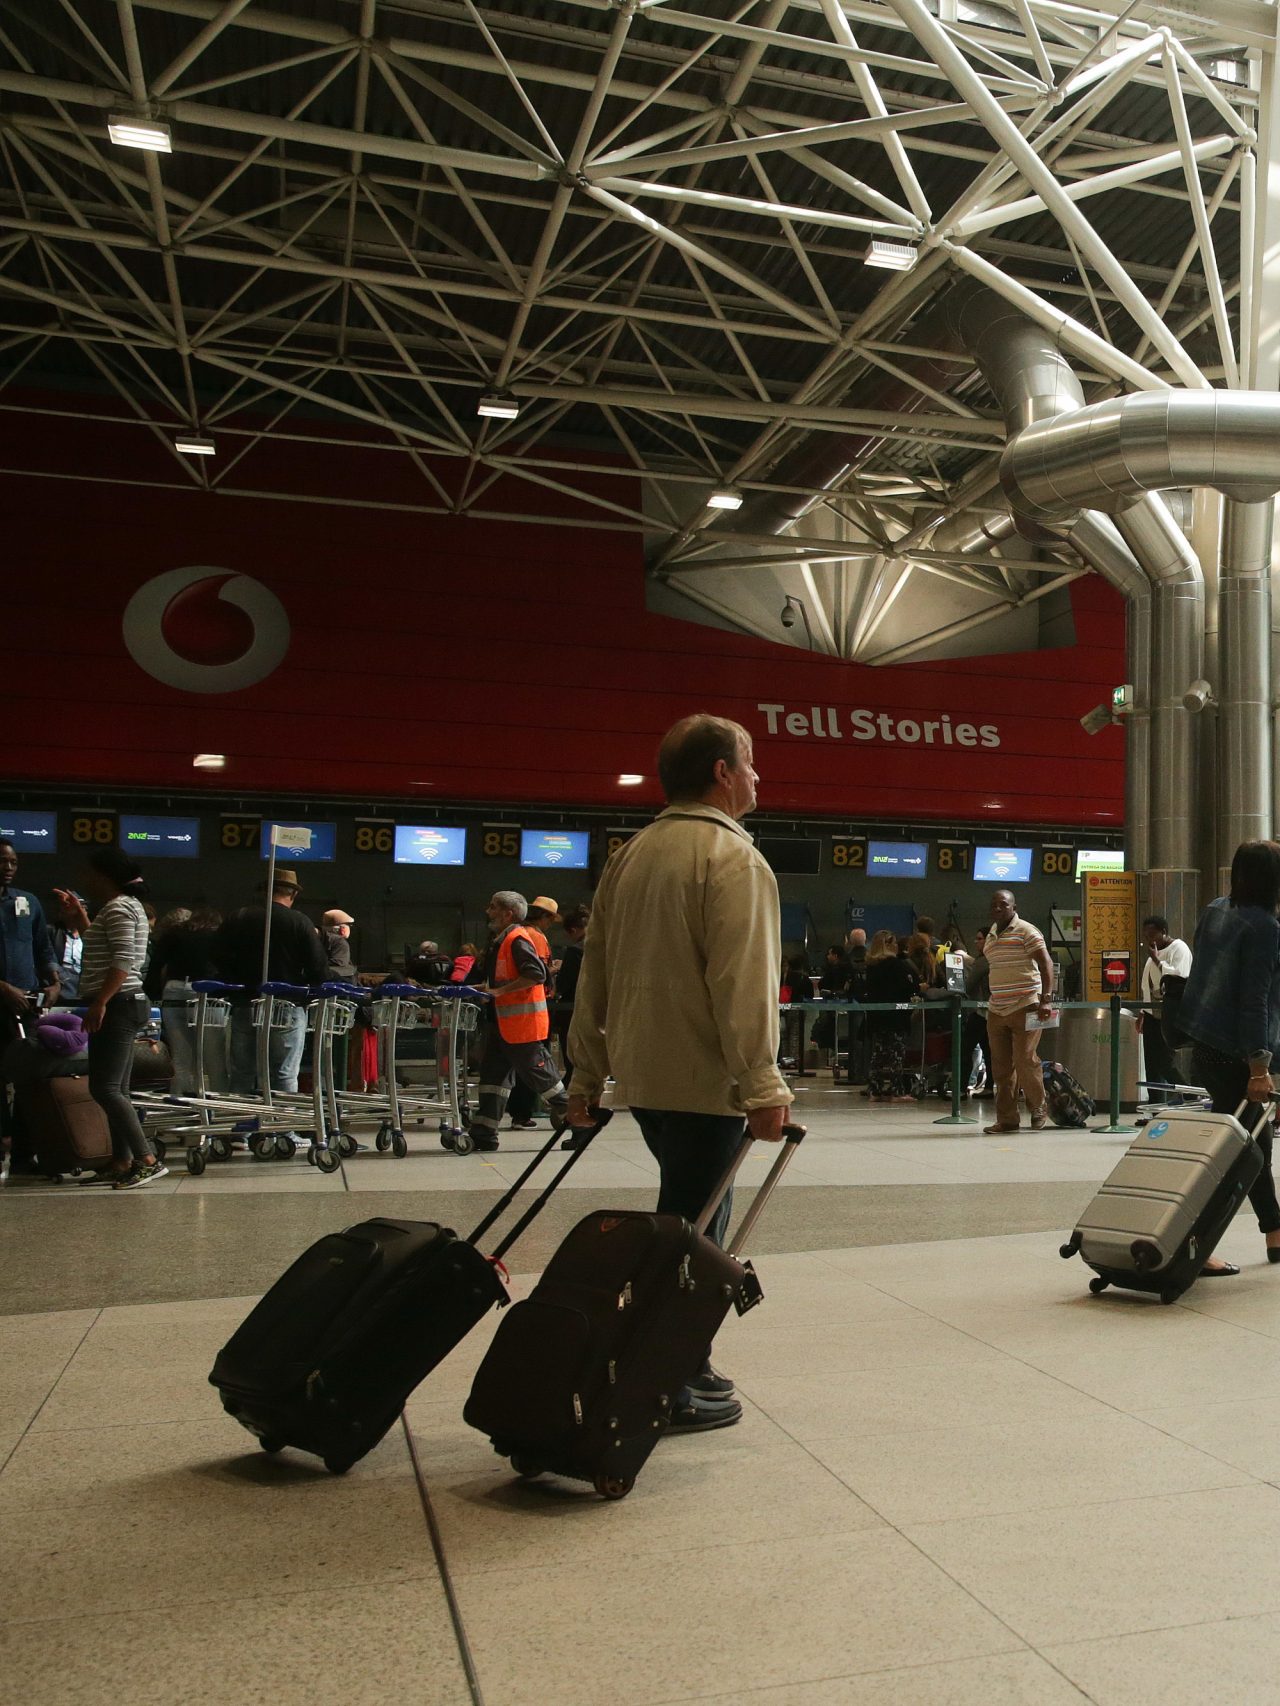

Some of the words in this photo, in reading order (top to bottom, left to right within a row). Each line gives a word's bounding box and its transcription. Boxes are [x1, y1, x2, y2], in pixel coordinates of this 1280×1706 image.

[758, 703, 842, 739] Tell
[851, 709, 1001, 748] Stories
[72, 818, 113, 844] 88
[222, 823, 260, 848] 87
[356, 827, 392, 852] 86
[483, 832, 519, 856] 85
[833, 844, 864, 867] 82
[938, 848, 968, 870] 81
[1043, 852, 1071, 874] 80
[1100, 878, 1133, 886] ATTENTION
